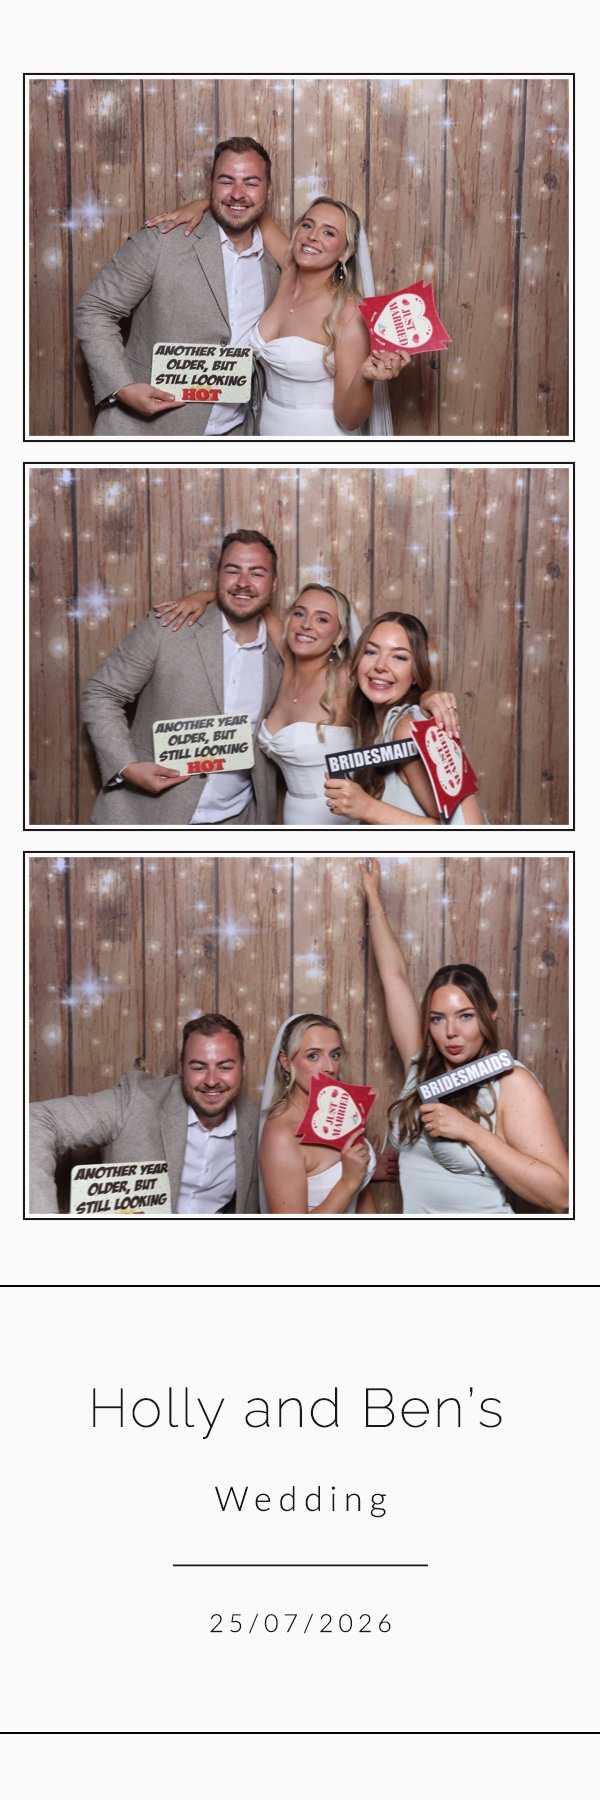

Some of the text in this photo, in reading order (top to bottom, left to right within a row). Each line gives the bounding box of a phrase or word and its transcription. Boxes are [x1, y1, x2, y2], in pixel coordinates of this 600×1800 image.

[389, 302, 408, 346] MARRIED
[402, 309, 416, 331] JUST
[154, 345, 251, 358] ANOTHER YEAR
[166, 359, 237, 373] OLDER, BUT
[155, 374, 247, 386] STILL LOOKING
[182, 388, 222, 401] HOT
[155, 715, 248, 734] ANOTHER YEAR
[168, 729, 237, 746] OLDER, BUT
[159, 742, 249, 762] STILL LOOKING
[328, 741, 419, 773] BRIDESMAID
[187, 758, 226, 774] HOT
[420, 1052, 512, 1100] BRIDESMAIDS
[326, 1101, 338, 1125] JUST
[332, 1093, 349, 1137] MARRIED
[74, 1163, 168, 1180] ANOTHER YEAR
[87, 1178, 158, 1196] OLDER, BUT
[75, 1193, 168, 1214] STILL LOOKING
